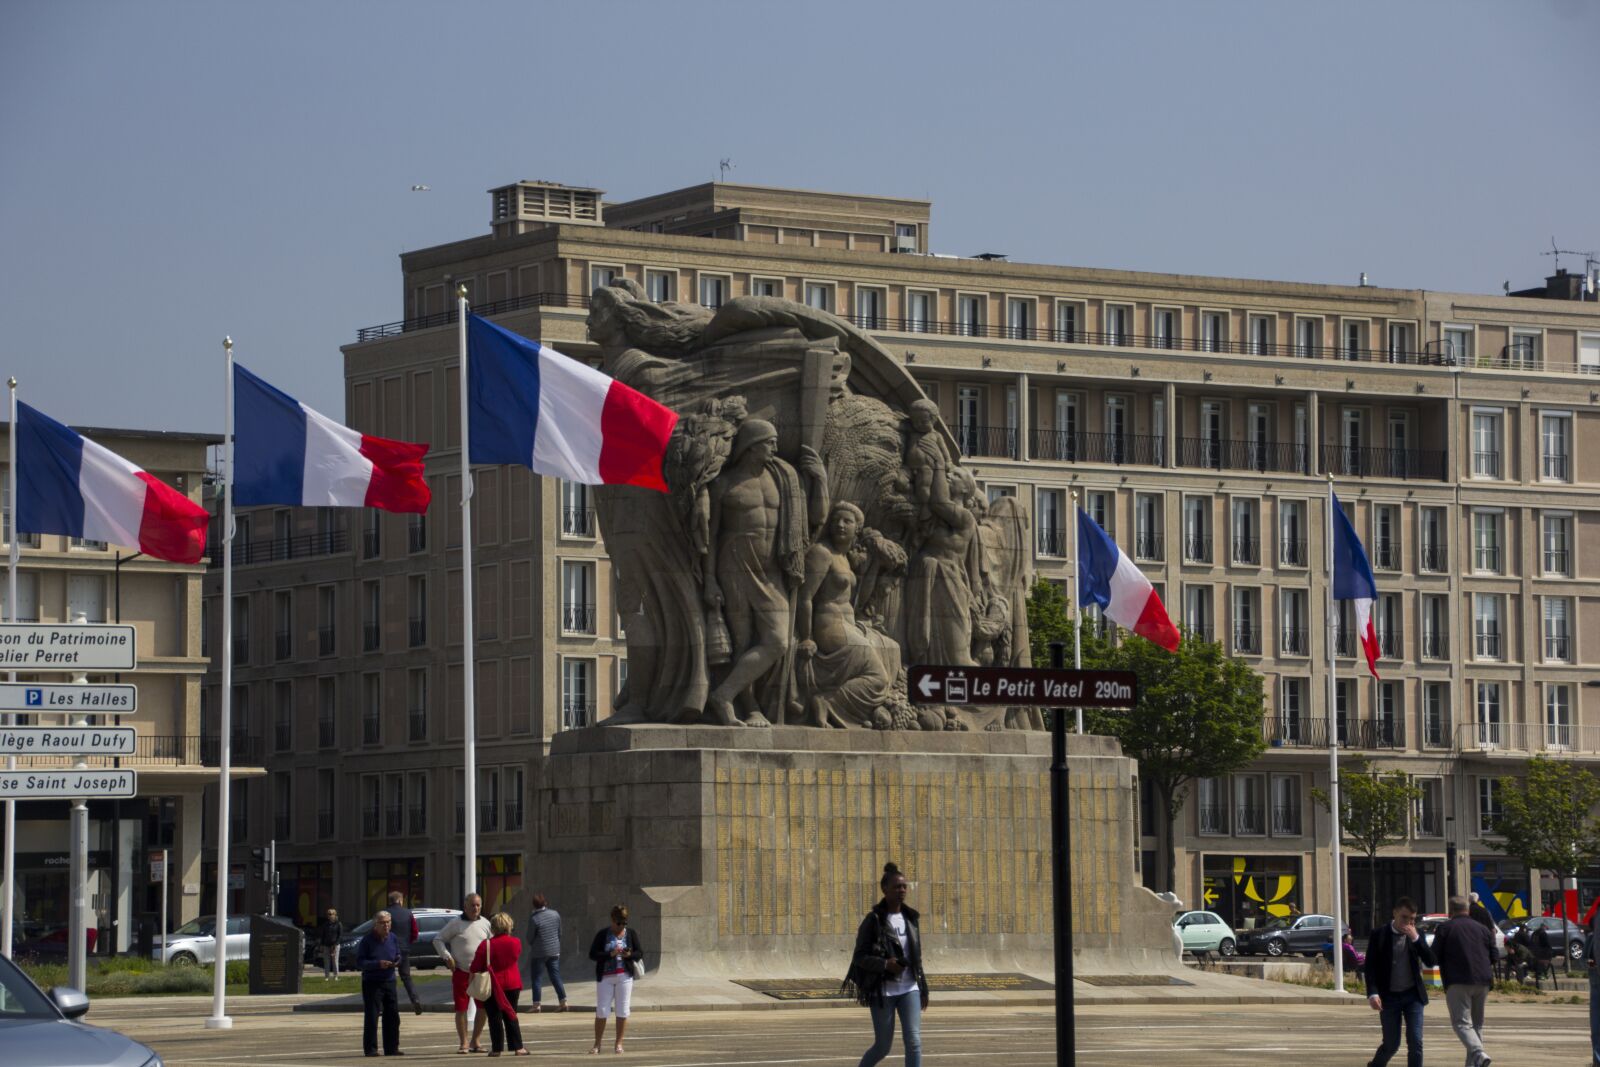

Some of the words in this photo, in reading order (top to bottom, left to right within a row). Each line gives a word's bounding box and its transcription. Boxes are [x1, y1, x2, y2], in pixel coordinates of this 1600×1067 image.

[28, 632, 43, 644] du
[50, 632, 126, 645] Patrimoine
[36, 650, 78, 662] Perret
[973, 678, 990, 695] Le
[997, 679, 1035, 696] Petit
[1044, 680, 1083, 697] Vatel
[1096, 681, 1131, 698] 290m
[29, 691, 39, 704] P
[50, 692, 73, 704] Les
[81, 692, 127, 705] Halles
[0, 733, 34, 750] lège
[42, 734, 85, 746] Raoul
[92, 734, 126, 749] Dufy
[0, 776, 18, 789] se
[26, 776, 66, 789] Saint
[74, 776, 126, 791] Joseph
